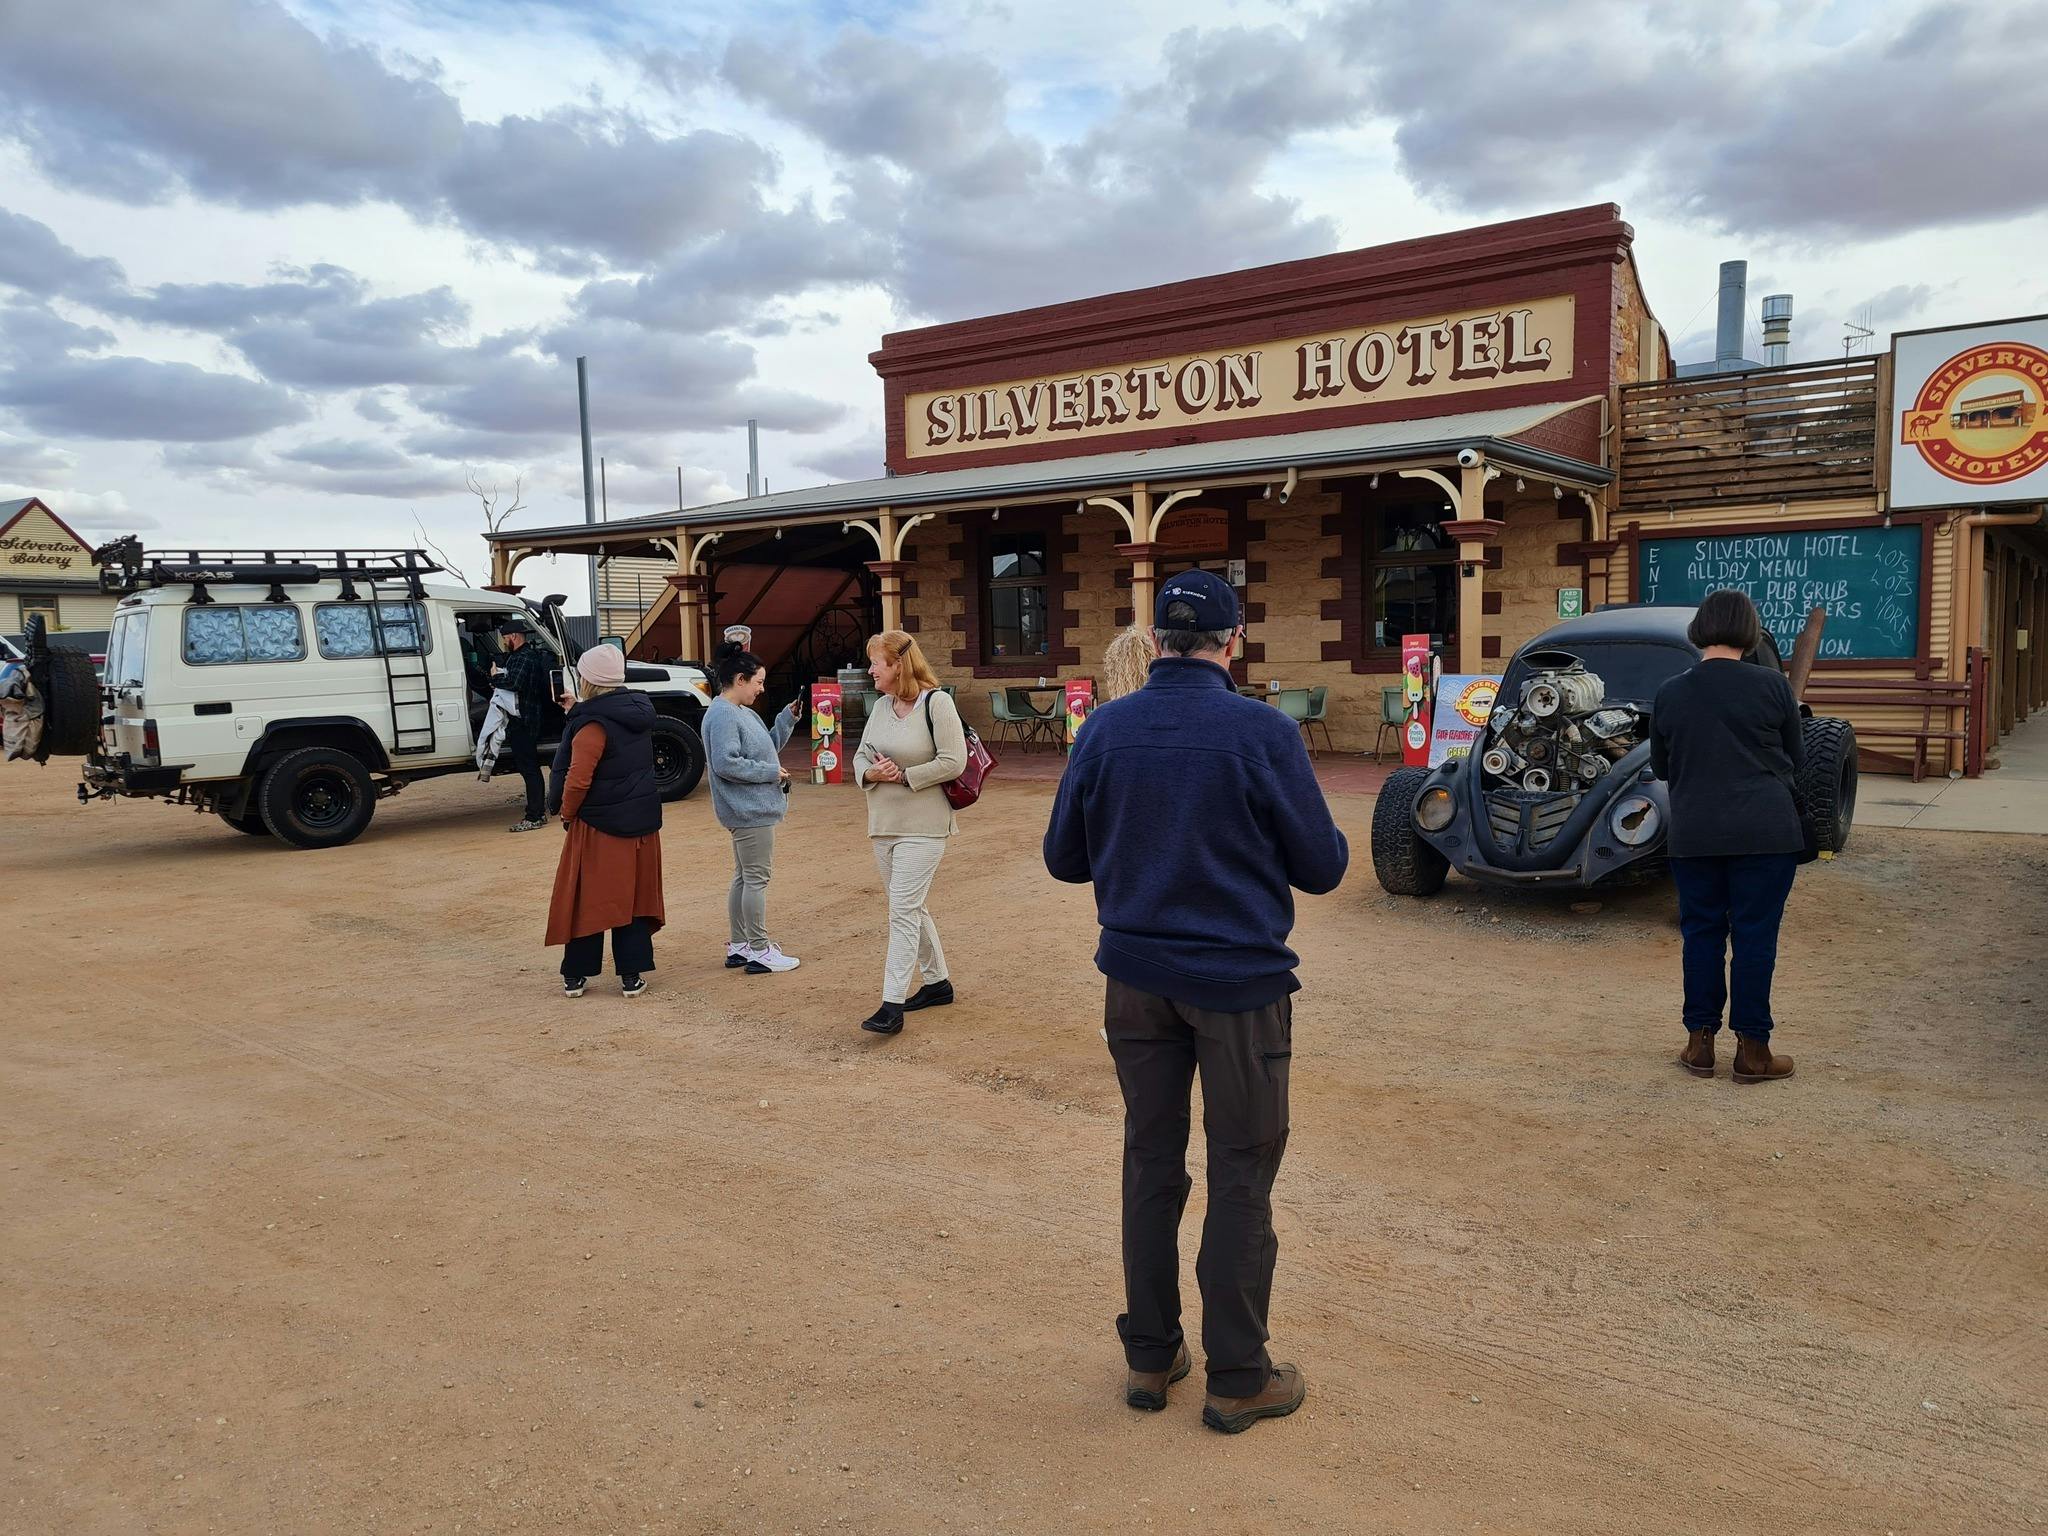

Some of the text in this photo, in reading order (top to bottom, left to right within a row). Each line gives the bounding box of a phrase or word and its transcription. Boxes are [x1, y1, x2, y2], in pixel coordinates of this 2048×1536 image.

[925, 309, 1552, 446] SILVERTON HOTEL
[1928, 351, 2048, 403] SILVERTO
[1944, 447, 2043, 474] HOTEL
[0, 536, 82, 552] Silverton
[1695, 535, 1862, 561] SILVERTON HOTEL
[9, 553, 72, 570] Bakery
[1688, 559, 1808, 580] ALL DAY MENU
[1875, 542, 1912, 574] LOTS
[1767, 580, 1797, 600] PUB
[1802, 580, 1848, 600] GRUB
[1871, 569, 1913, 596] LOTS
[1759, 601, 1794, 618] OLD
[1874, 594, 1911, 640] MORE
